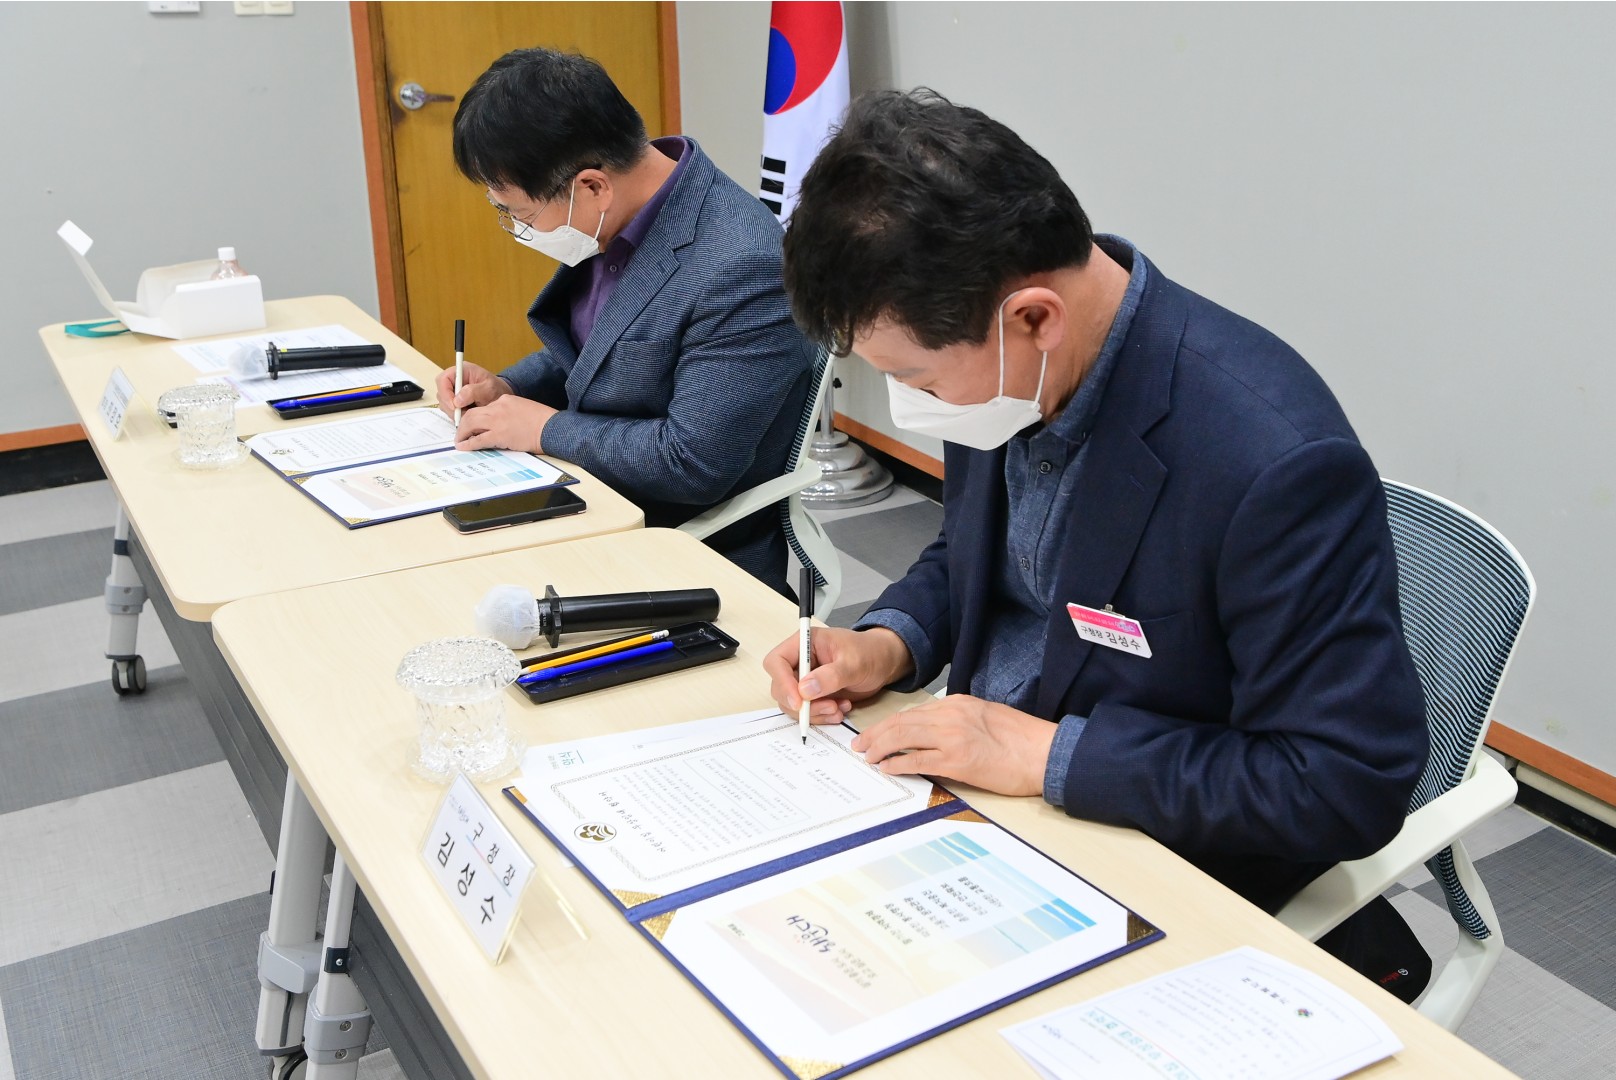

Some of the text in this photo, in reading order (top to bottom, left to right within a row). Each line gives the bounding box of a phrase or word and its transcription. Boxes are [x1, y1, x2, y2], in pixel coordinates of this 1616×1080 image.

[1105, 631, 1141, 650] 김성수
[436, 832, 496, 925] 김성수
[472, 821, 517, 887] 구청장
[786, 915, 836, 953] 해운대
